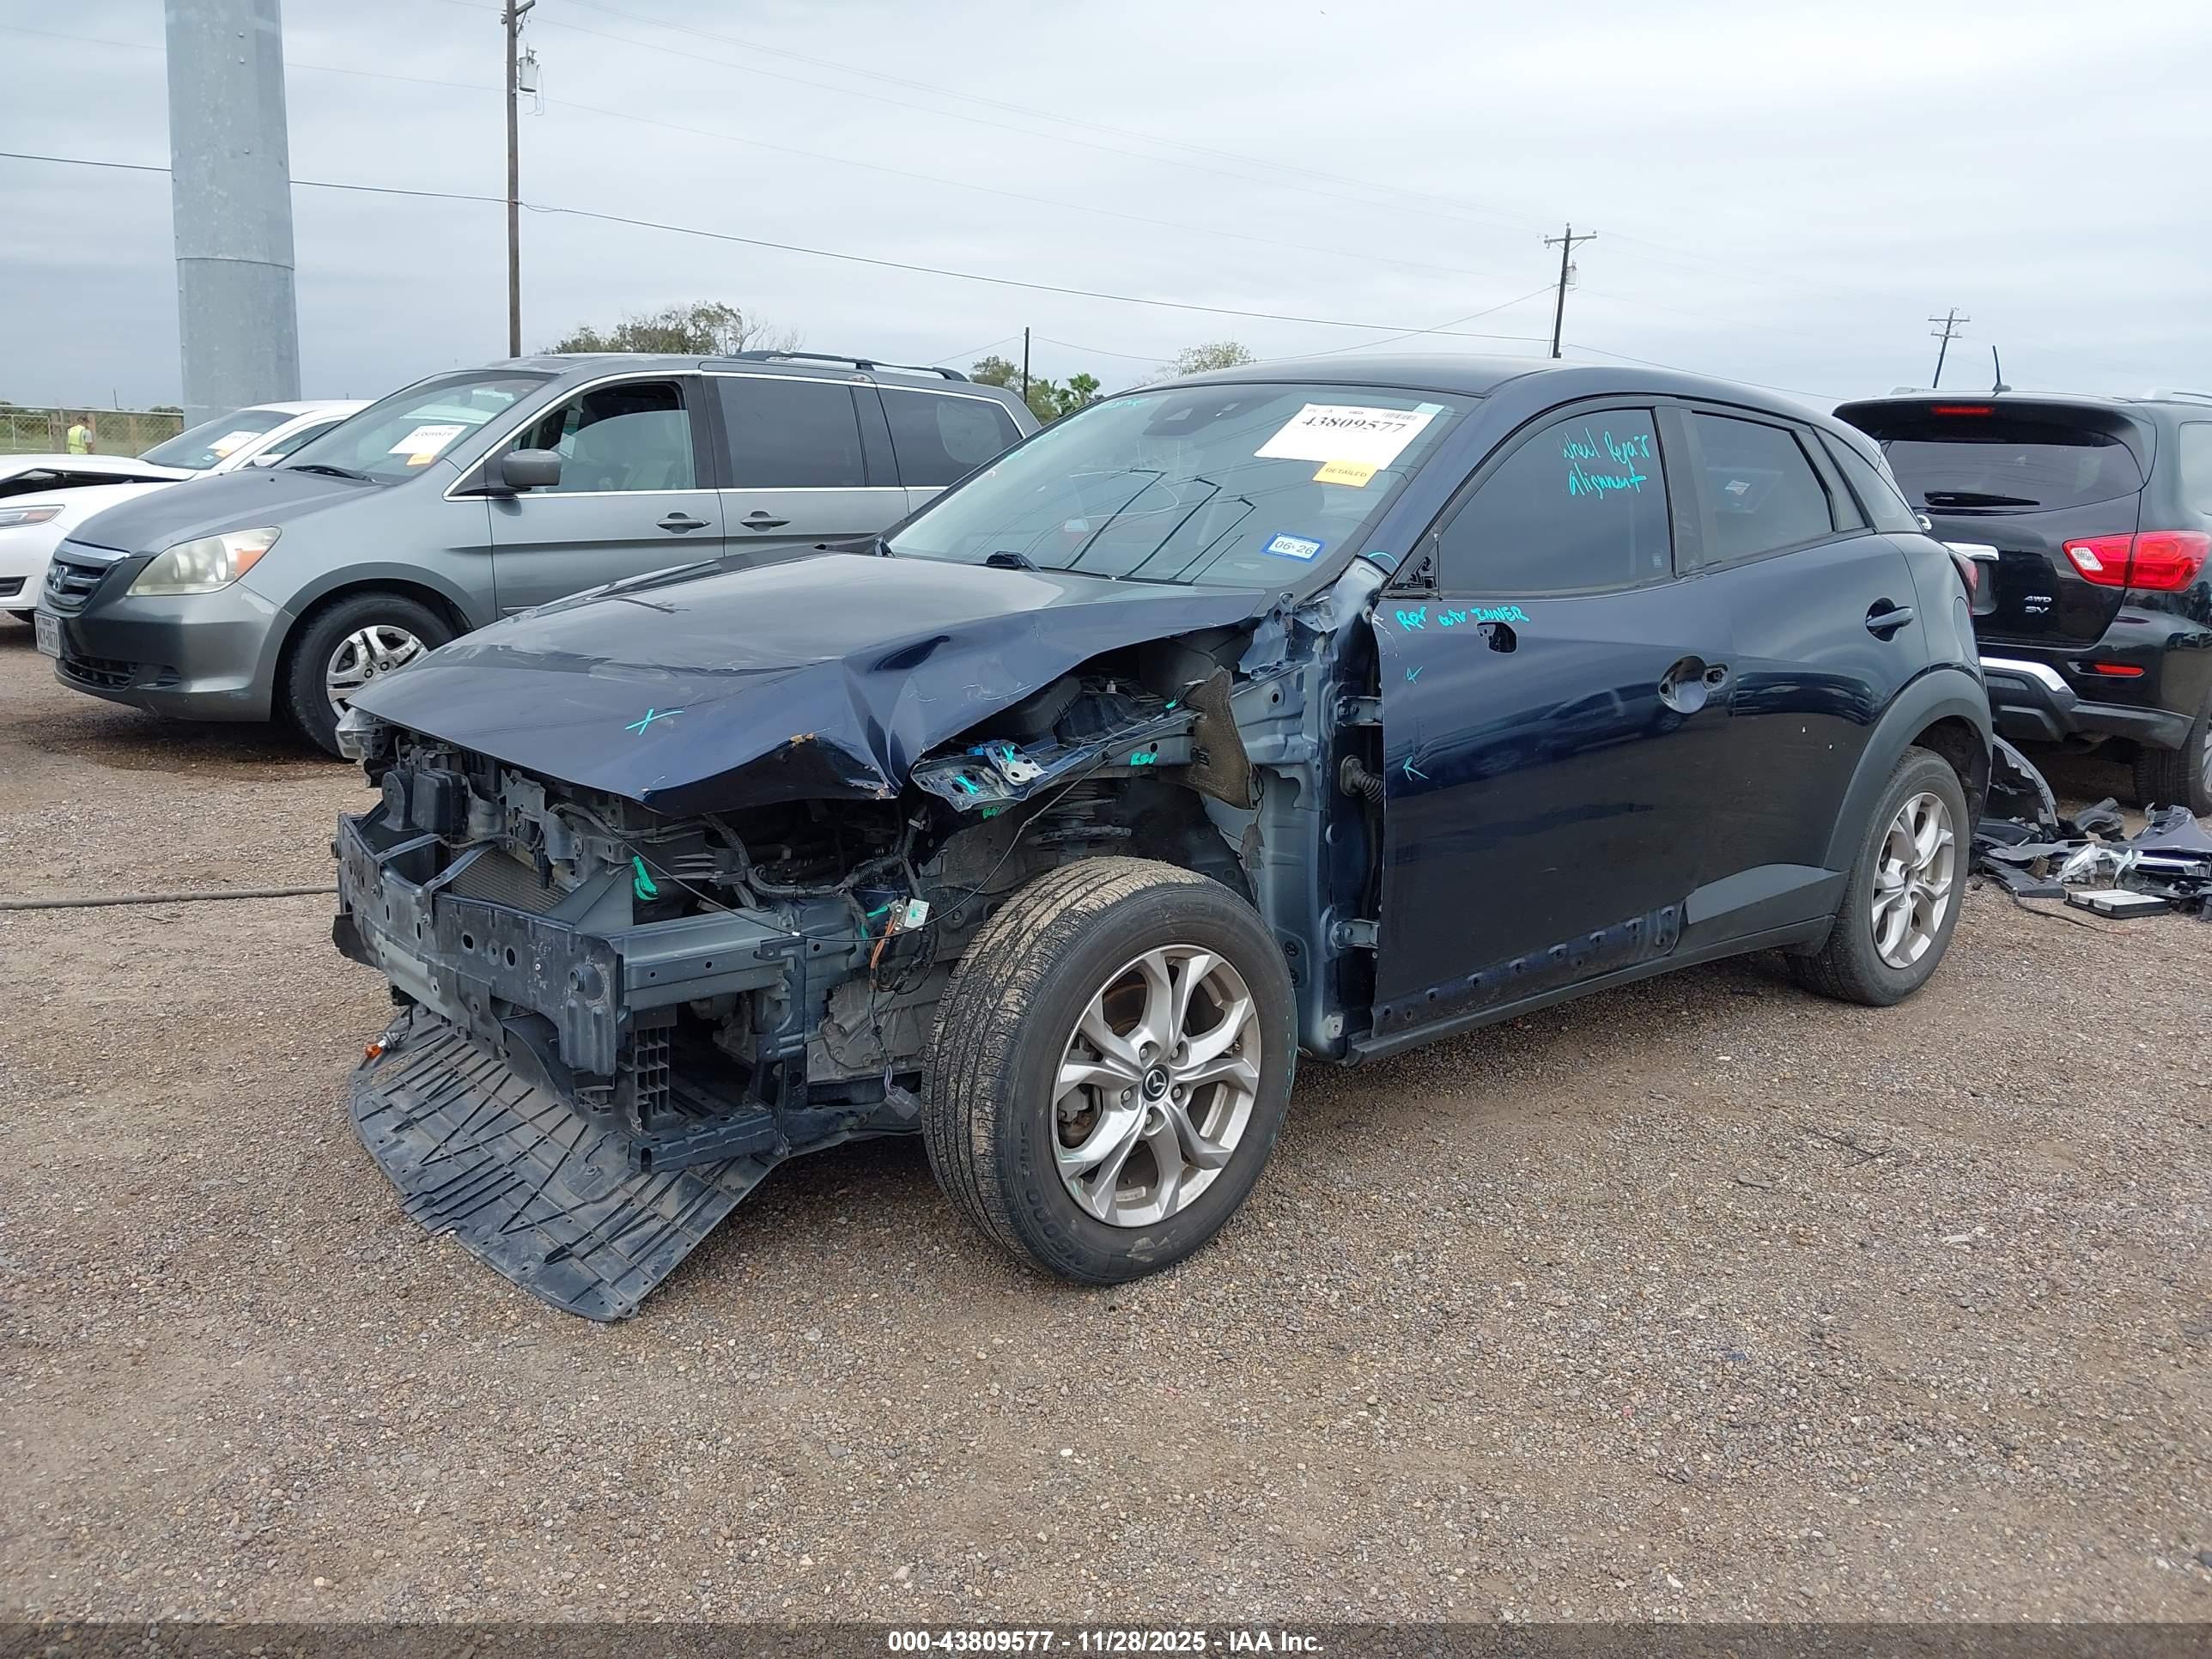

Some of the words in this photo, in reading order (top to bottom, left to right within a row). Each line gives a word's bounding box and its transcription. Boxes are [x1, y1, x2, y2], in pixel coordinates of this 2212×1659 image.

[1302, 416, 1407, 433] 43809577
[1325, 467, 1368, 477] DETAILED
[1470, 605, 1530, 622] INNER
